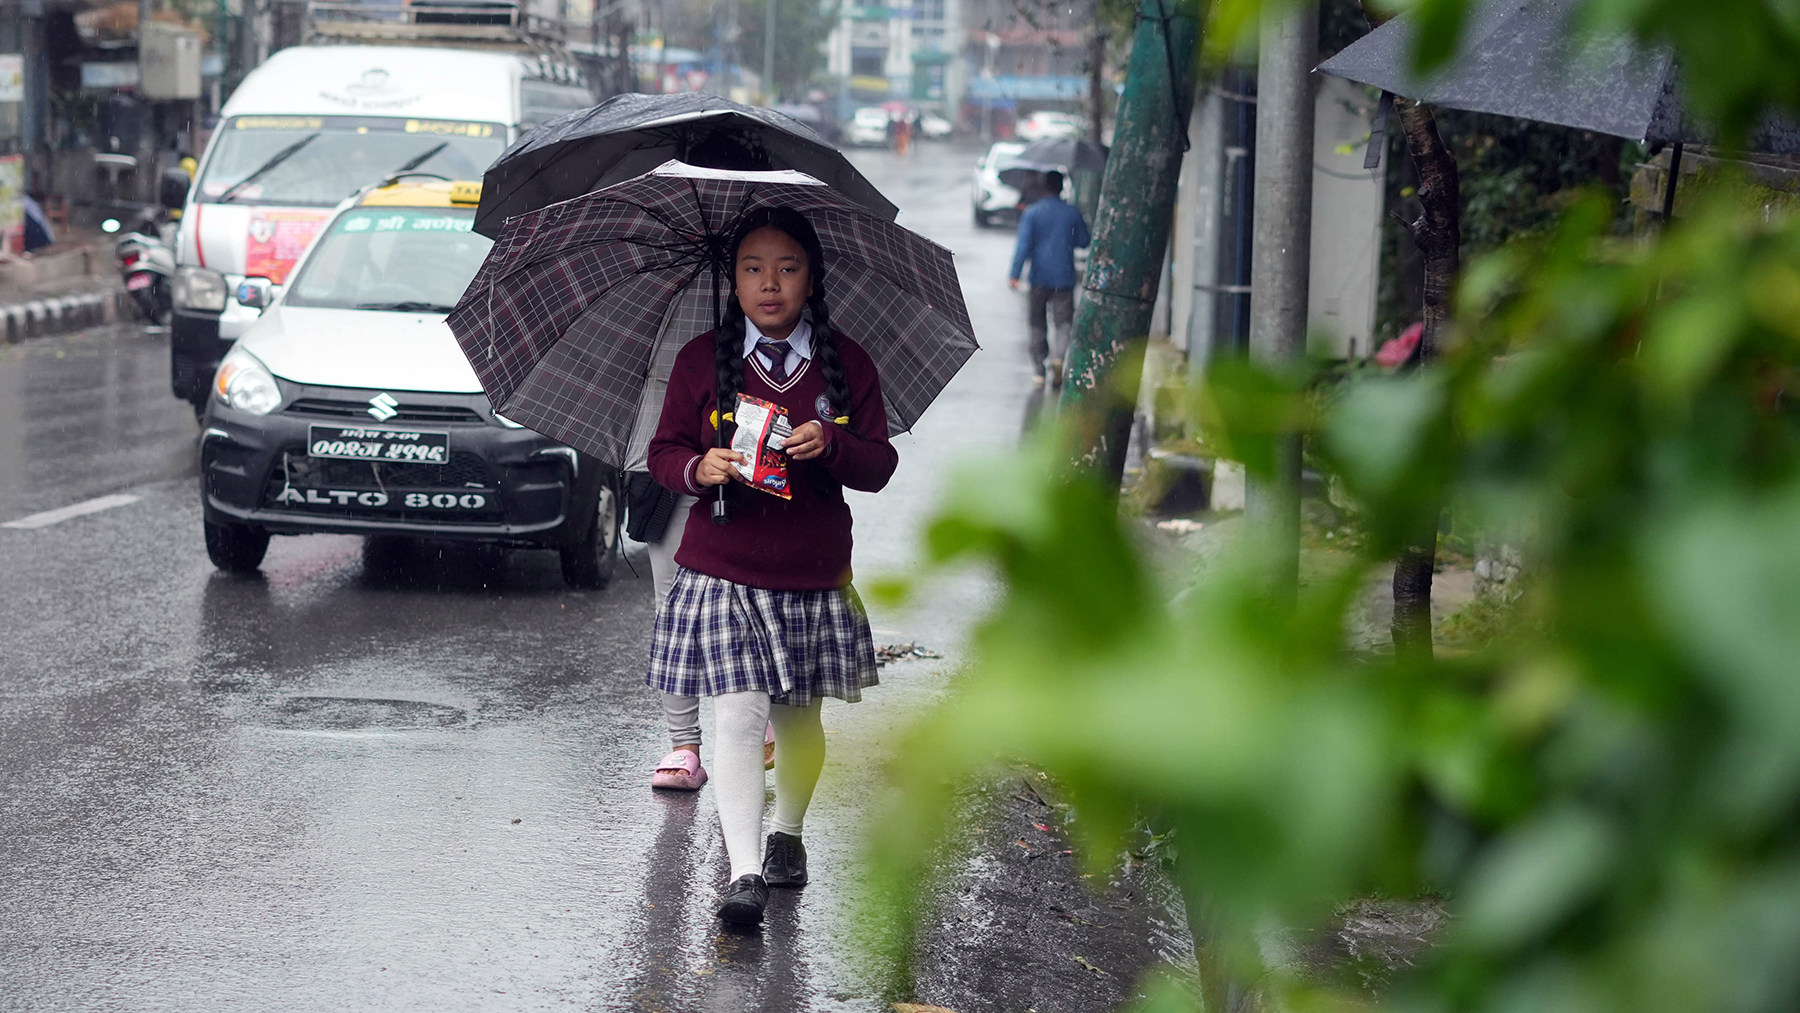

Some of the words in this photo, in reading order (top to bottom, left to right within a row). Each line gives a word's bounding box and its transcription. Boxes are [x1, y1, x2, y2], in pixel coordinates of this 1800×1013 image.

[457, 187, 480, 195] TAX
[375, 215, 406, 231] श्री
[276, 488, 389, 506] ALTO
[404, 493, 486, 509] 800
